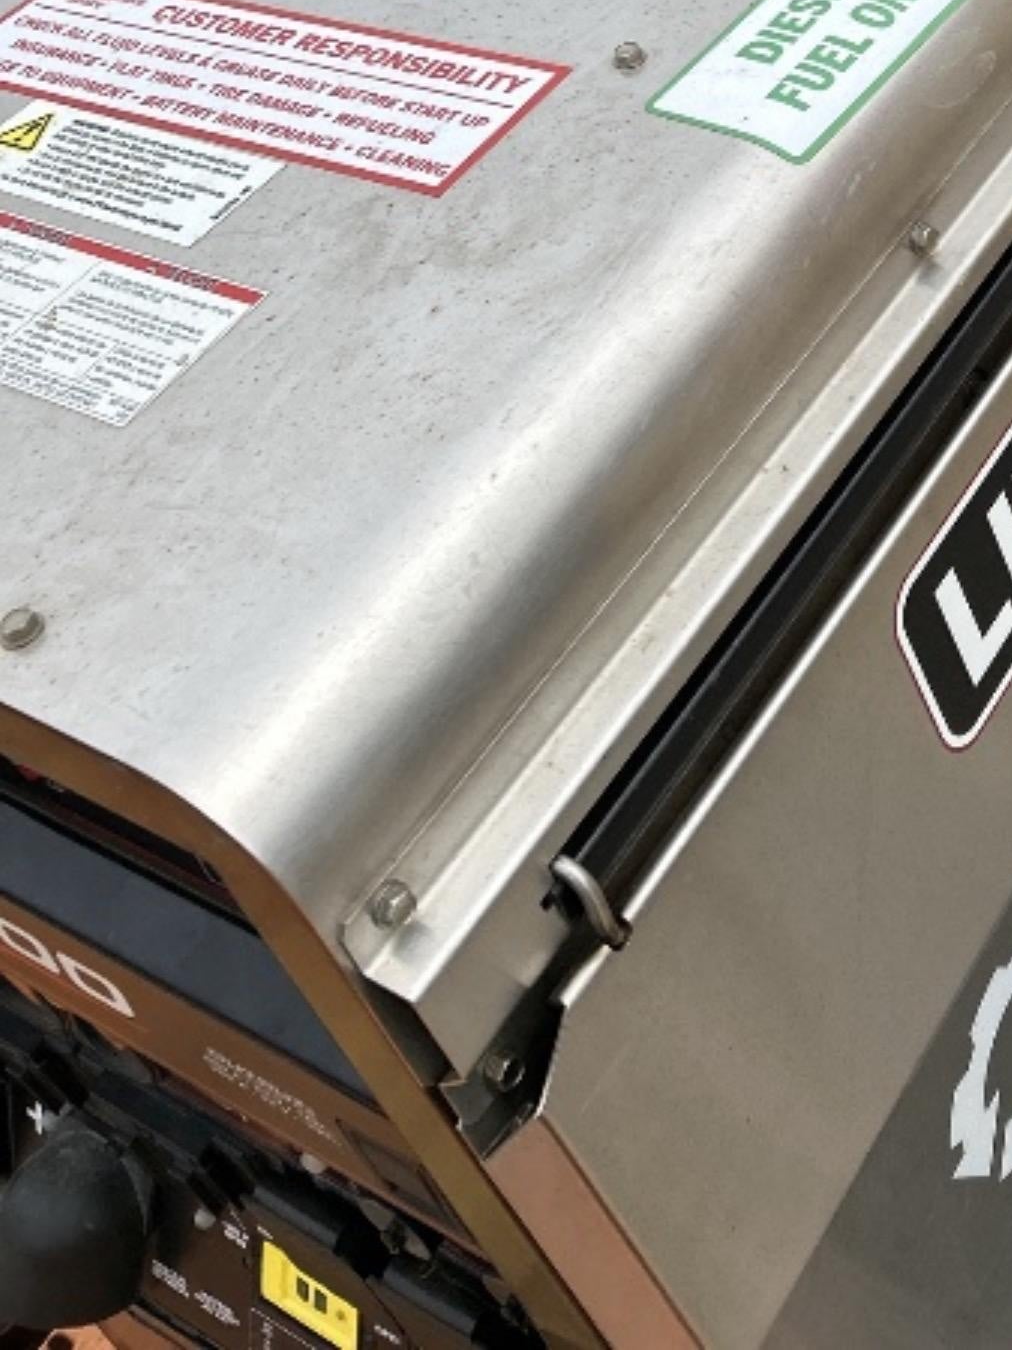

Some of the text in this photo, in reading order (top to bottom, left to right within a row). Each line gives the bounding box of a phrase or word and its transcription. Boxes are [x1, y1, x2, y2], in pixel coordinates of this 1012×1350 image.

[152, 4, 532, 94] CUSTOMER RESPONSIBILITY
[765, 34, 874, 111] FUEL
[38, 70, 134, 99] EQUIPMENT
[140, 93, 216, 120] BATTERY
[212, 110, 345, 151] MAINTENANCE
[354, 145, 452, 177] CLEANING
[208, 82, 250, 103] TIRE
[333, 111, 437, 146] REFUELING
[328, 84, 396, 109] BEFORE
[399, 100, 463, 122] START
[461, 113, 491, 128] UP
